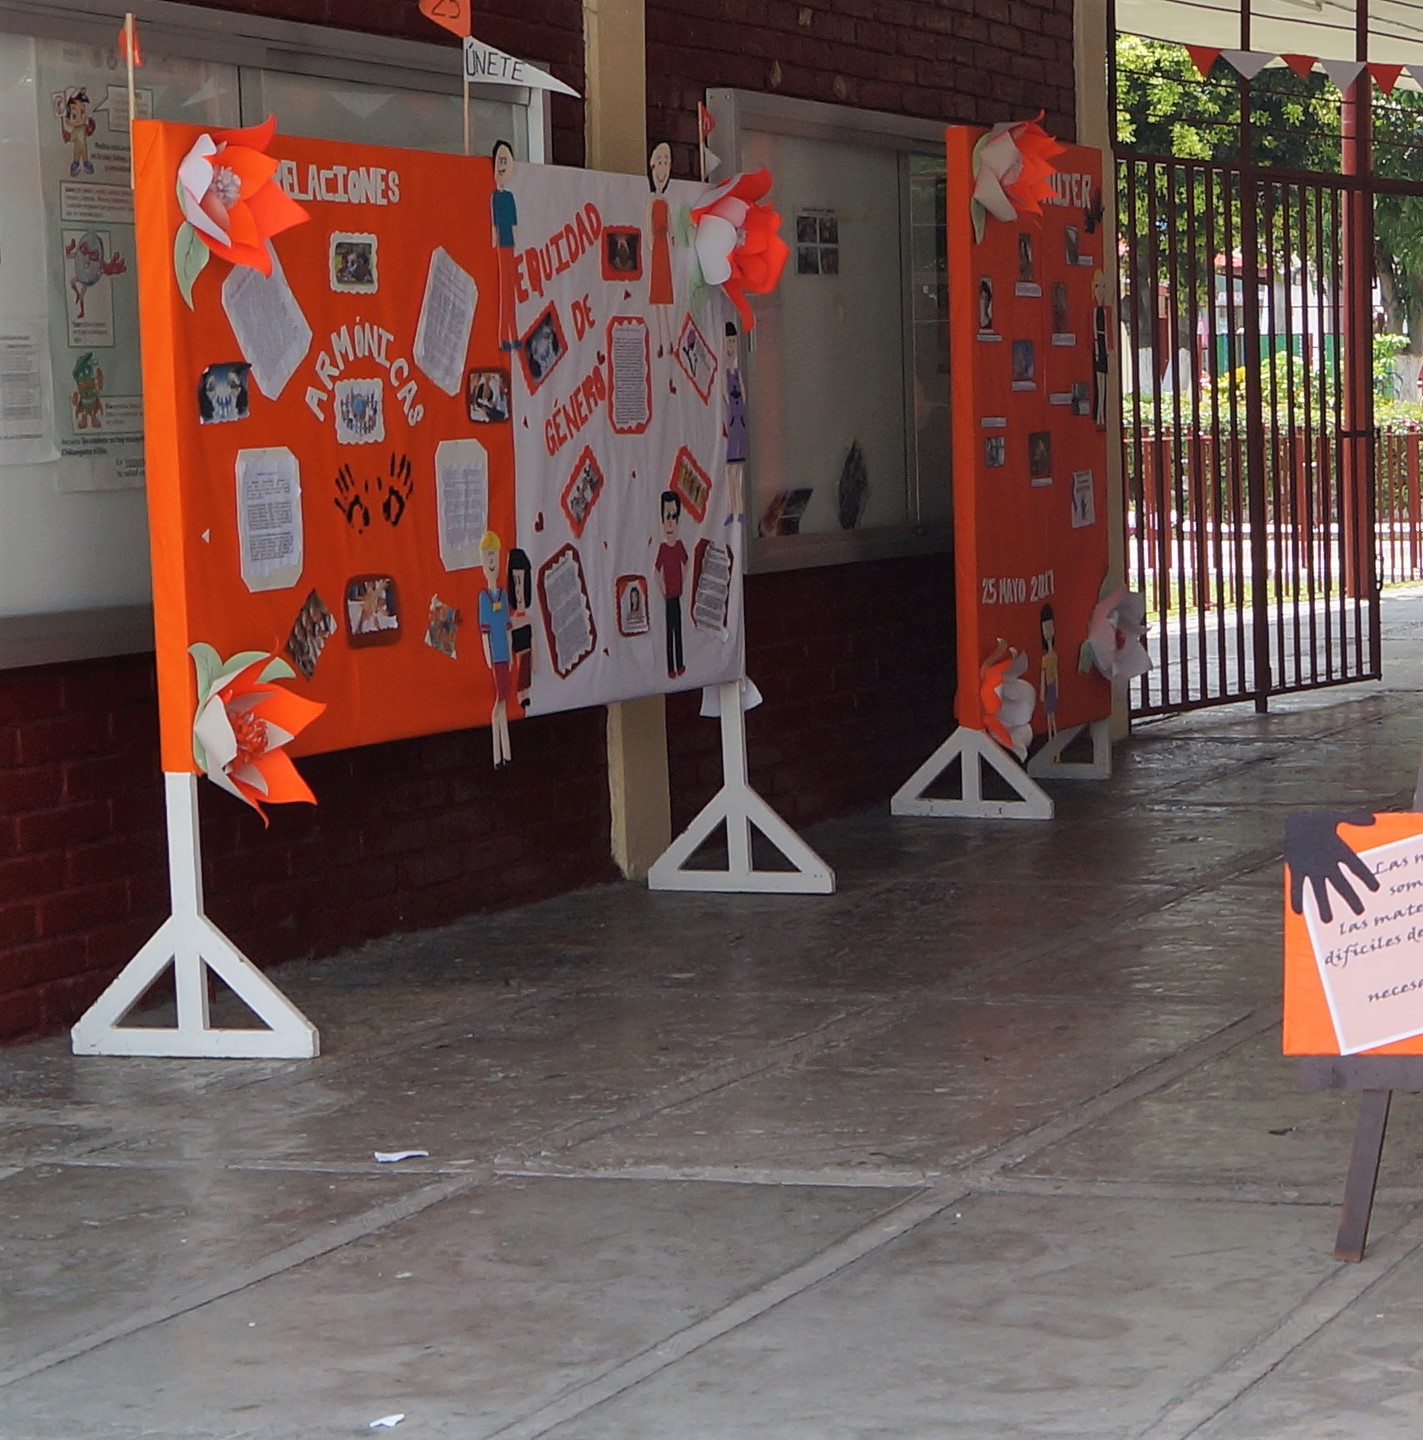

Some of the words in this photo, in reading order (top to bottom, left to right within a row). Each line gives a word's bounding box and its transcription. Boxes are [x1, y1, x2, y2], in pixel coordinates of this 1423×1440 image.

[466, 43, 524, 82] ÚNETE
[514, 202, 602, 304] EQUIDAD
[570, 293, 596, 341] DE
[305, 316, 424, 426] ARMÓNICAS
[544, 365, 606, 457] GÉNERO
[982, 577, 998, 604] 25
[1374, 857, 1408, 875] Las
[1325, 935, 1402, 969] difíciles
